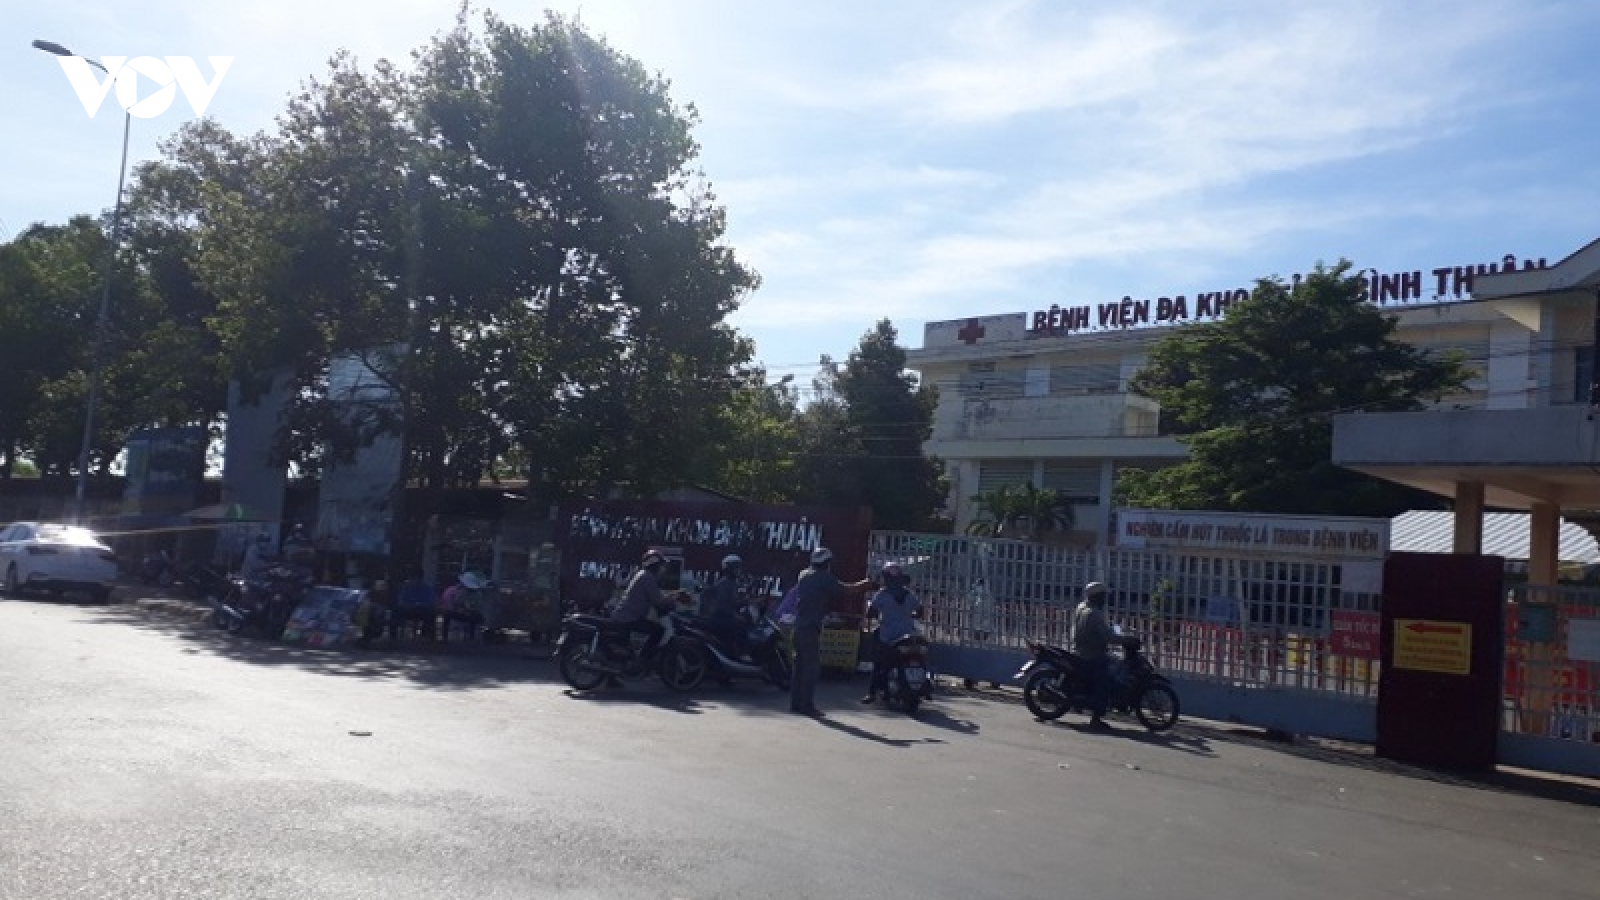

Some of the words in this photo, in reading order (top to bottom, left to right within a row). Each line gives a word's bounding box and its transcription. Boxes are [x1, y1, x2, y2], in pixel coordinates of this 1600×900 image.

[1097, 295, 1151, 329] VIỆN
[1157, 294, 1189, 321] ĐA
[1196, 286, 1252, 318] KHO
[1254, 521, 1269, 543] LÁ
[1349, 528, 1379, 551] VIỆN
